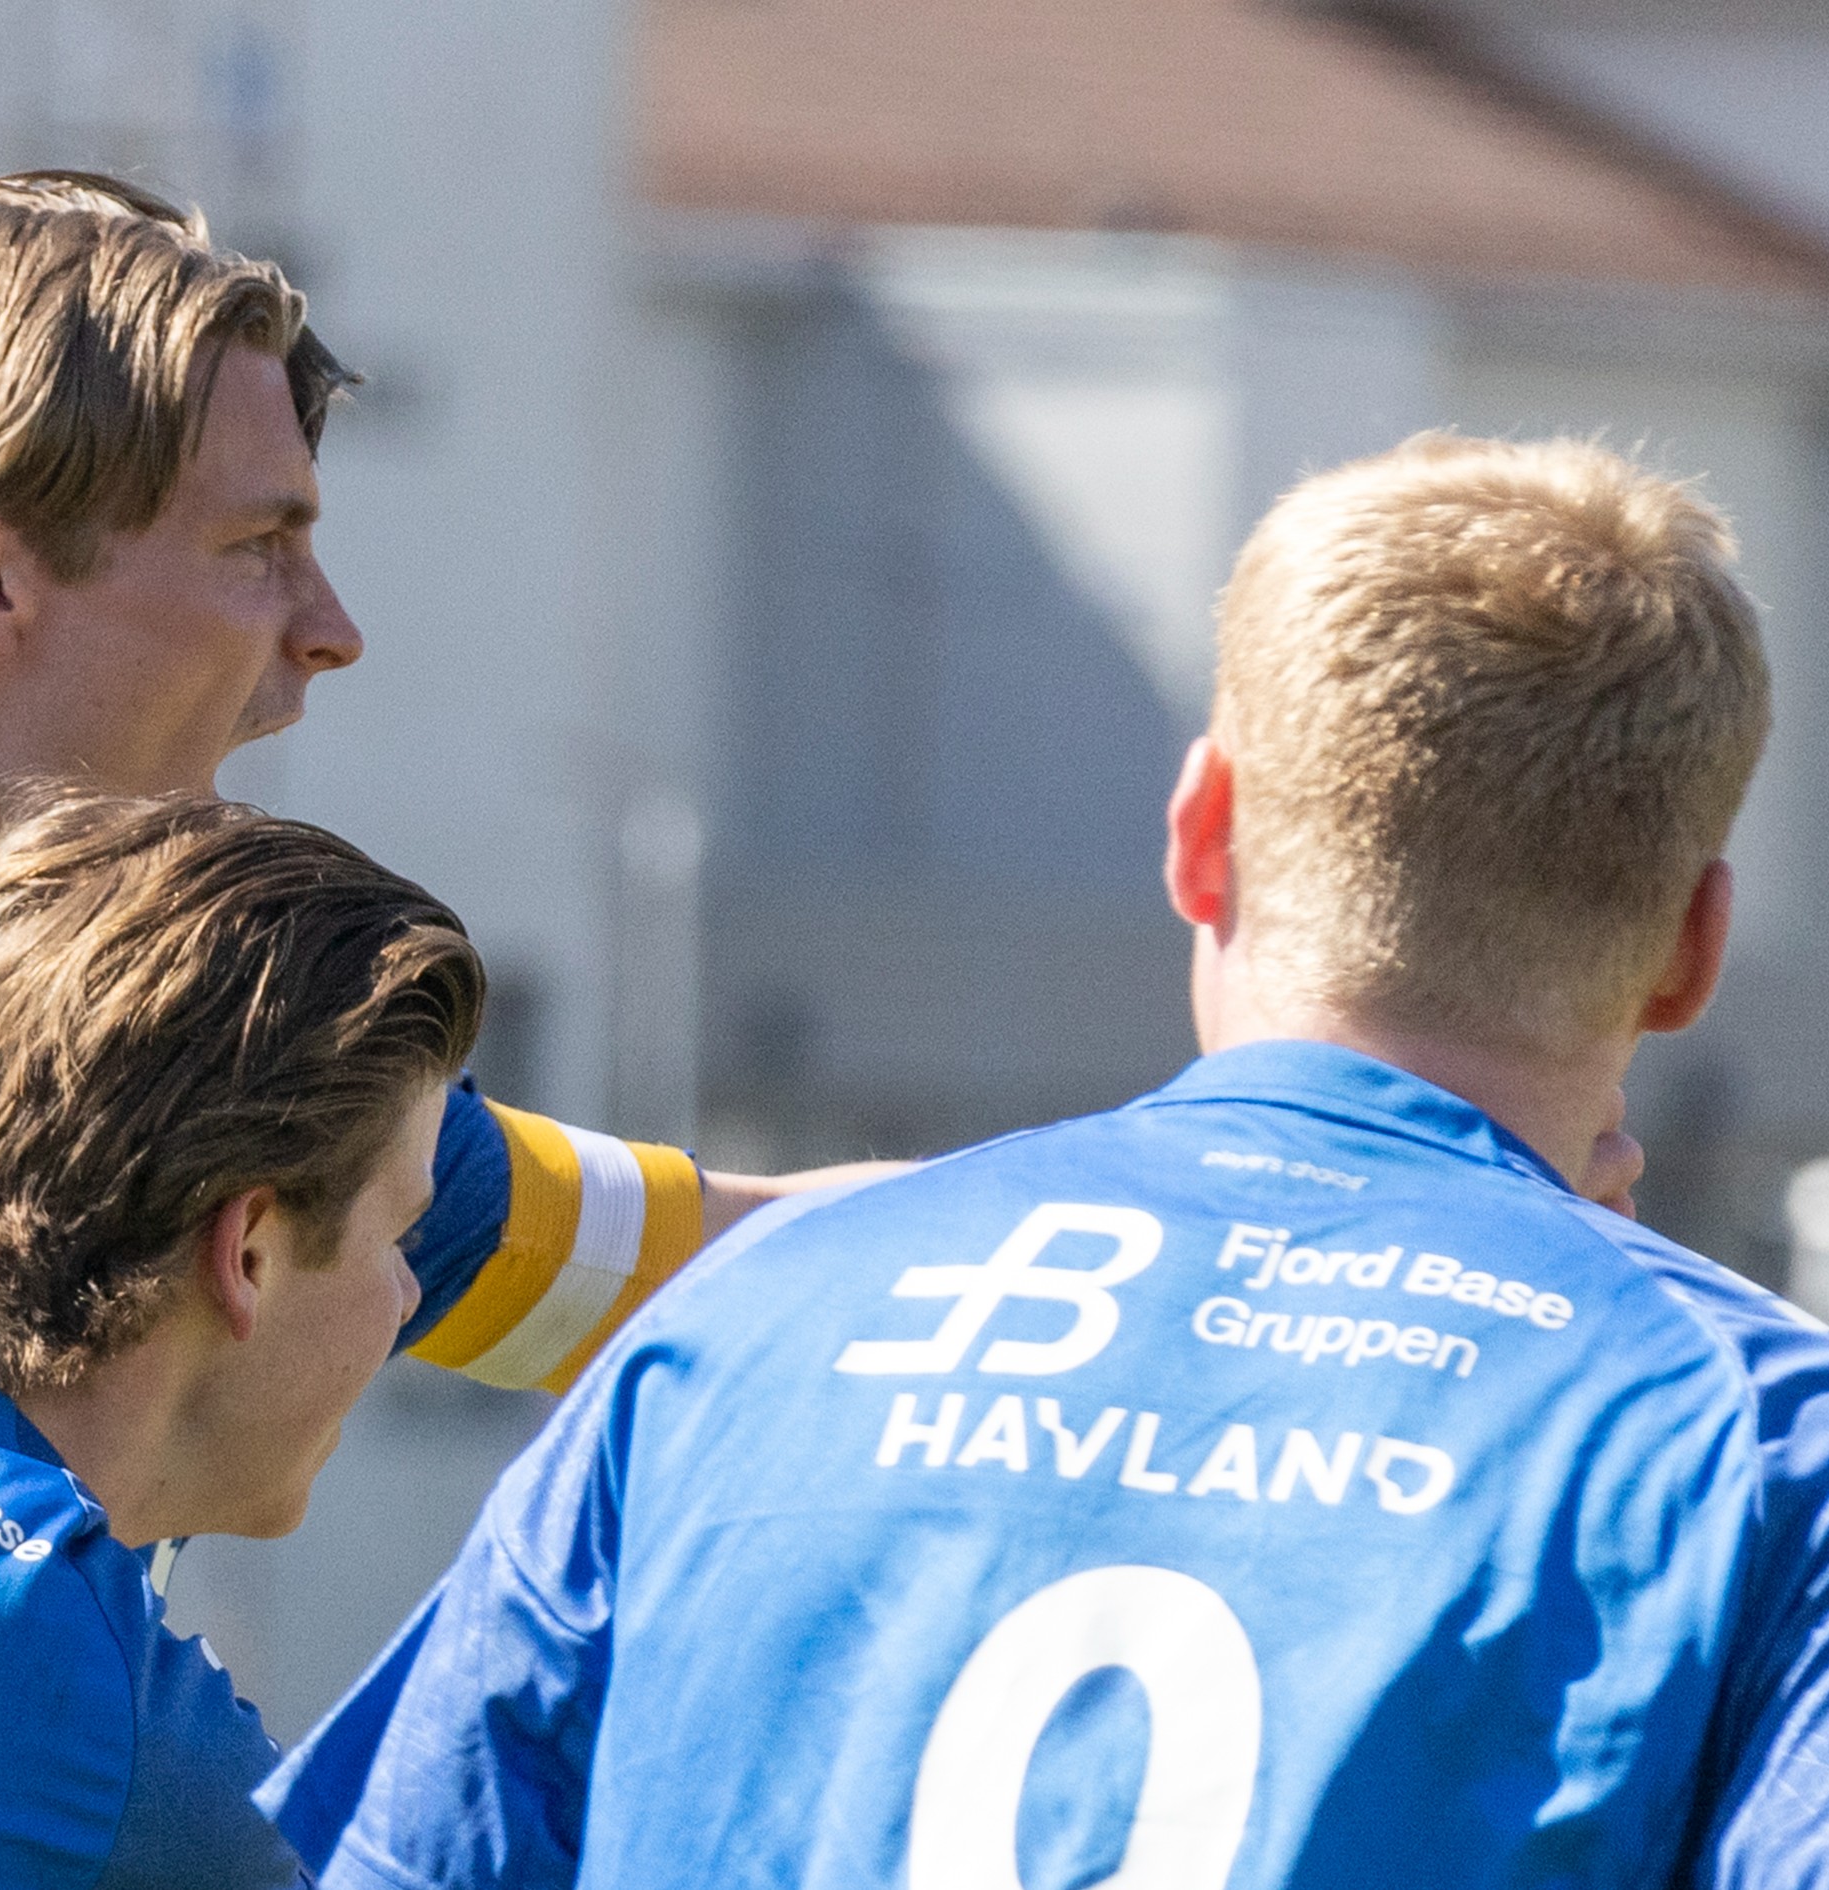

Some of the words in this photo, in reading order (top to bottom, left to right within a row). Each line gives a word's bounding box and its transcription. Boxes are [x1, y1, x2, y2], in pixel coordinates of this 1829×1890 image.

[1216, 1222, 1404, 1290] Fjord
[1402, 1252, 1574, 1330] Base
[1191, 1296, 1479, 1378] Gruppen
[874, 1393, 1455, 1515] HAVLAND
